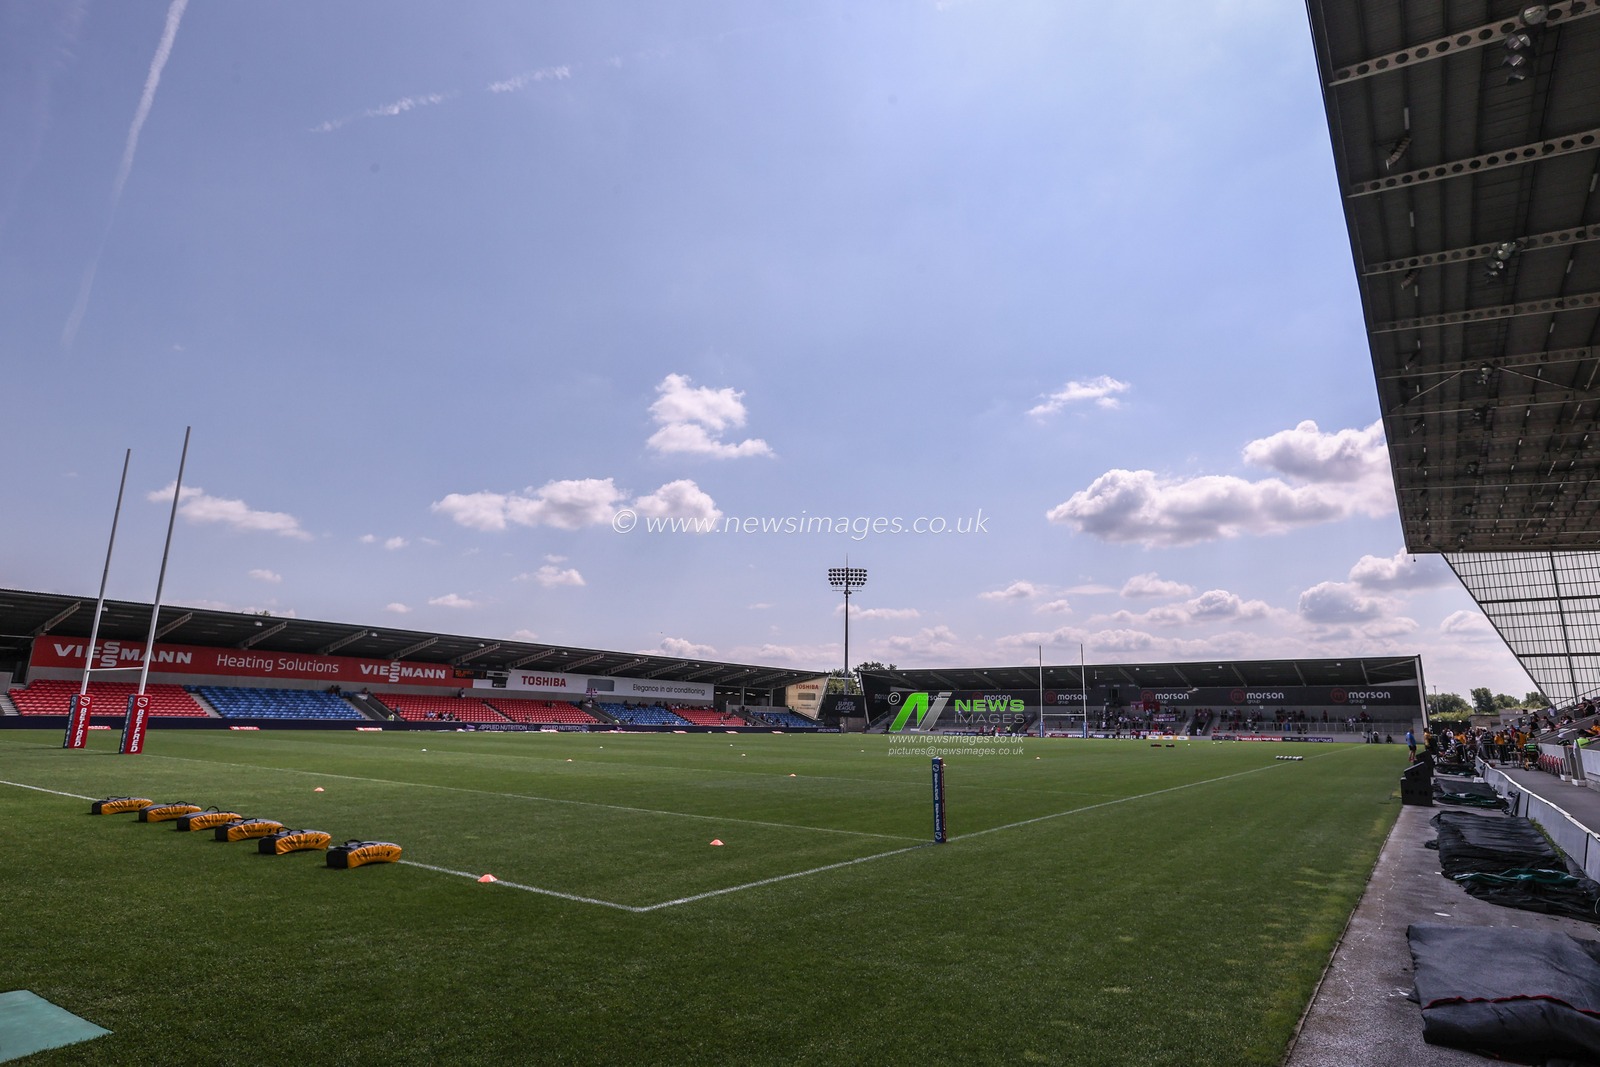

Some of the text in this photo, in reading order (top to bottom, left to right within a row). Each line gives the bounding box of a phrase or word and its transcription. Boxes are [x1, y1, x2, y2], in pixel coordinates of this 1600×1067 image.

[216, 654, 339, 673] Heating Solutions
[360, 661, 446, 683] VIESSMANN
[521, 675, 567, 688] TOSHIBA
[632, 683, 659, 693] Elegance
[674, 686, 706, 696] conditioning
[1348, 691, 1391, 699] morson
[74, 707, 88, 747] BETFRED
[130, 709, 145, 752] BETFRED
